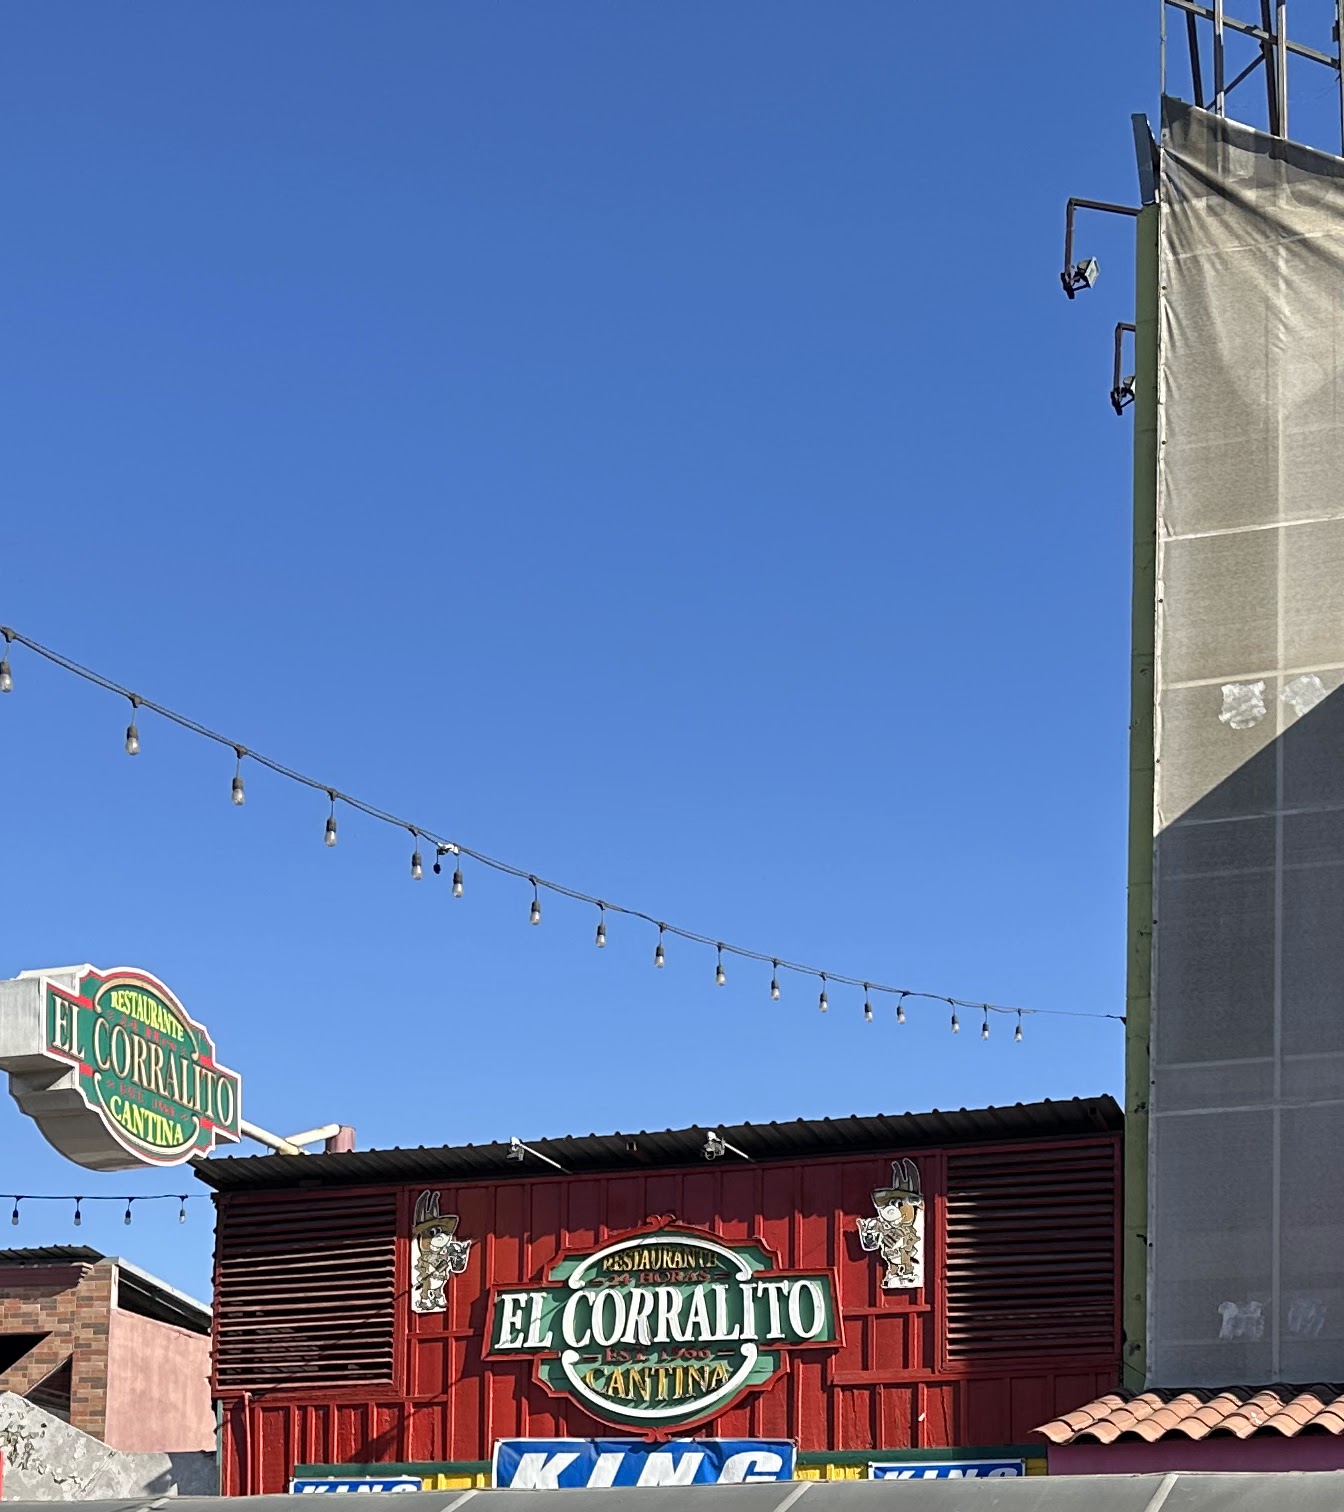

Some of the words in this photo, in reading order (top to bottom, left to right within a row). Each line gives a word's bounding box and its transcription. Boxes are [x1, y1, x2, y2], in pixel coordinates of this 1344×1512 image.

[110, 990, 185, 1042] RESTAURANTE
[52, 994, 85, 1061] EL
[93, 1016, 235, 1128] CORRALITO
[109, 1095, 185, 1146] CANTINA
[602, 1246, 720, 1273] RESTAURANTE
[638, 1270, 712, 1284] HORAS
[494, 1292, 553, 1351] EL
[561, 1279, 825, 1348] CORRALITO
[585, 1362, 730, 1402] CANTINA
